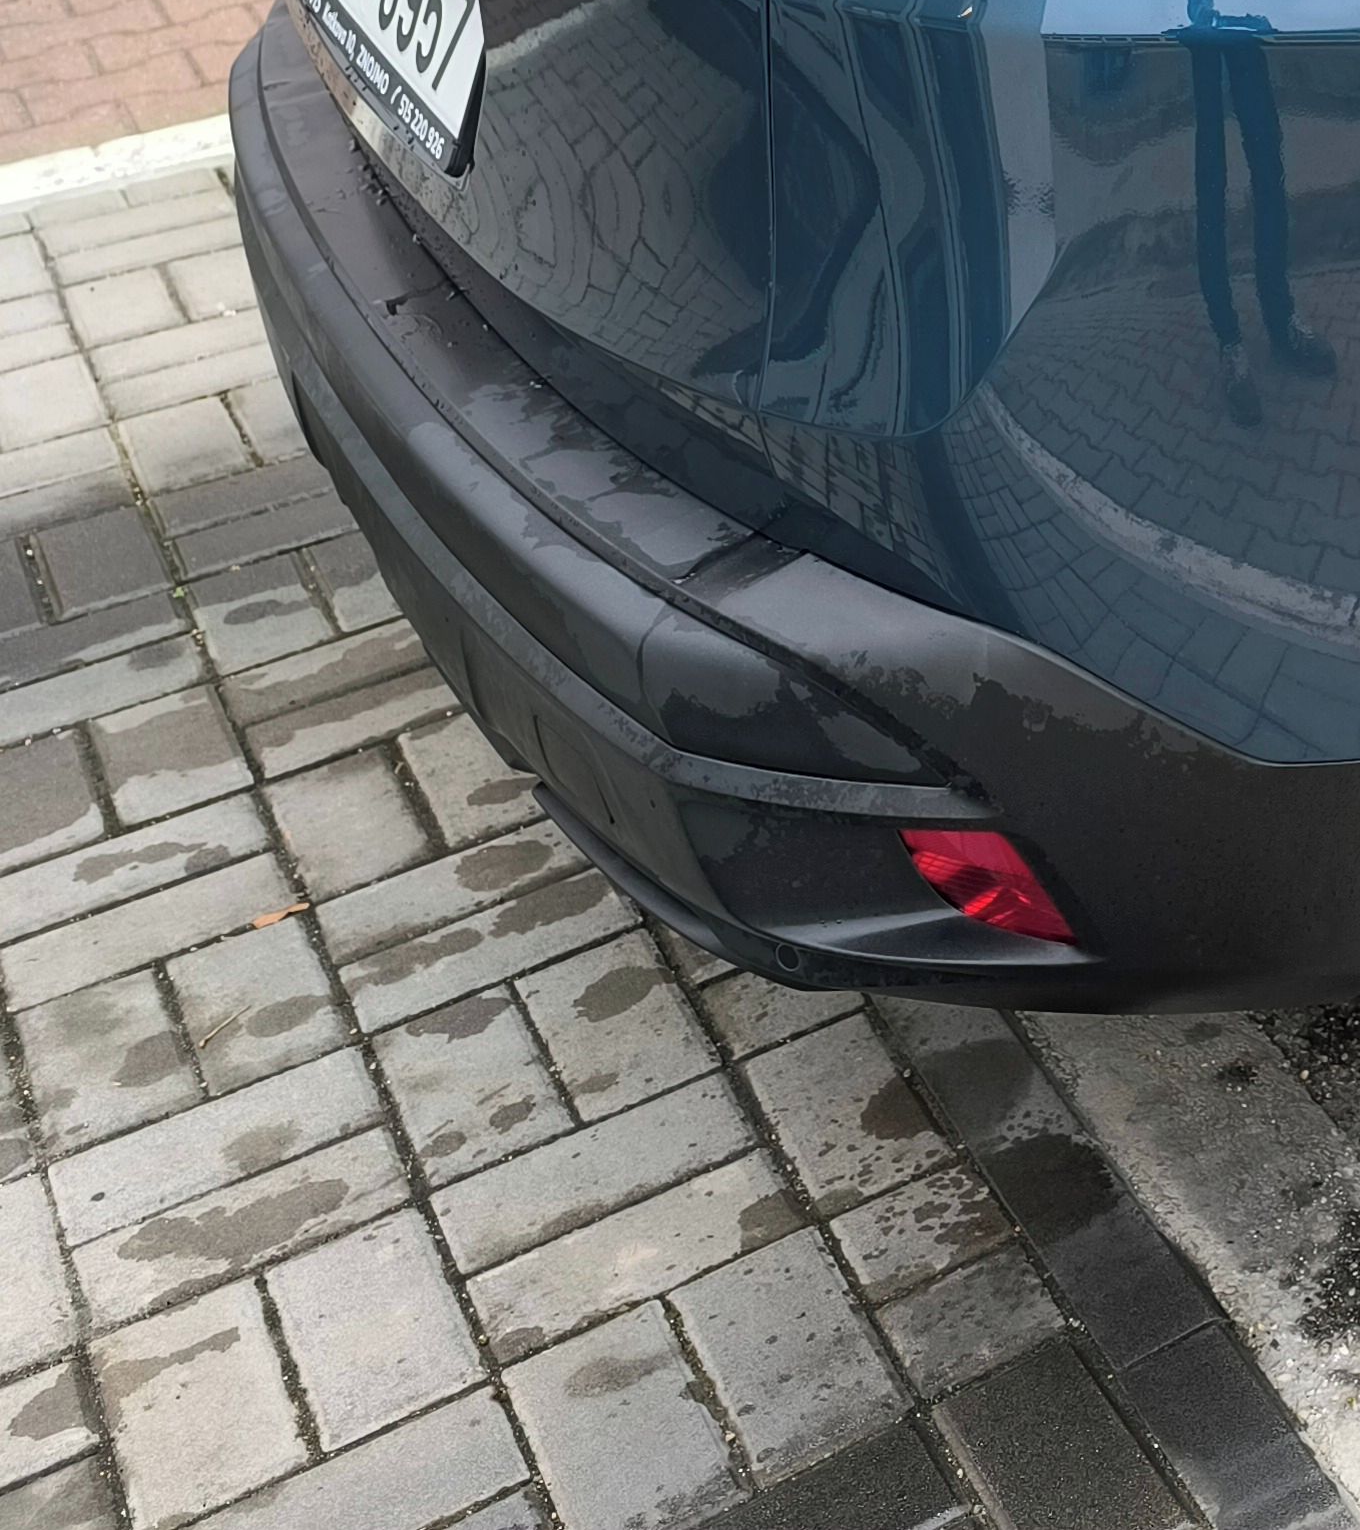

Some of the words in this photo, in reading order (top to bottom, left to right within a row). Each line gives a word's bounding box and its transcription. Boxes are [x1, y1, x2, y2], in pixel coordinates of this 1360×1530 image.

[356, 44, 390, 95] ZNOJMO
[398, 94, 414, 124] 515
[410, 108, 428, 141] 220
[426, 126, 445, 160] 926
